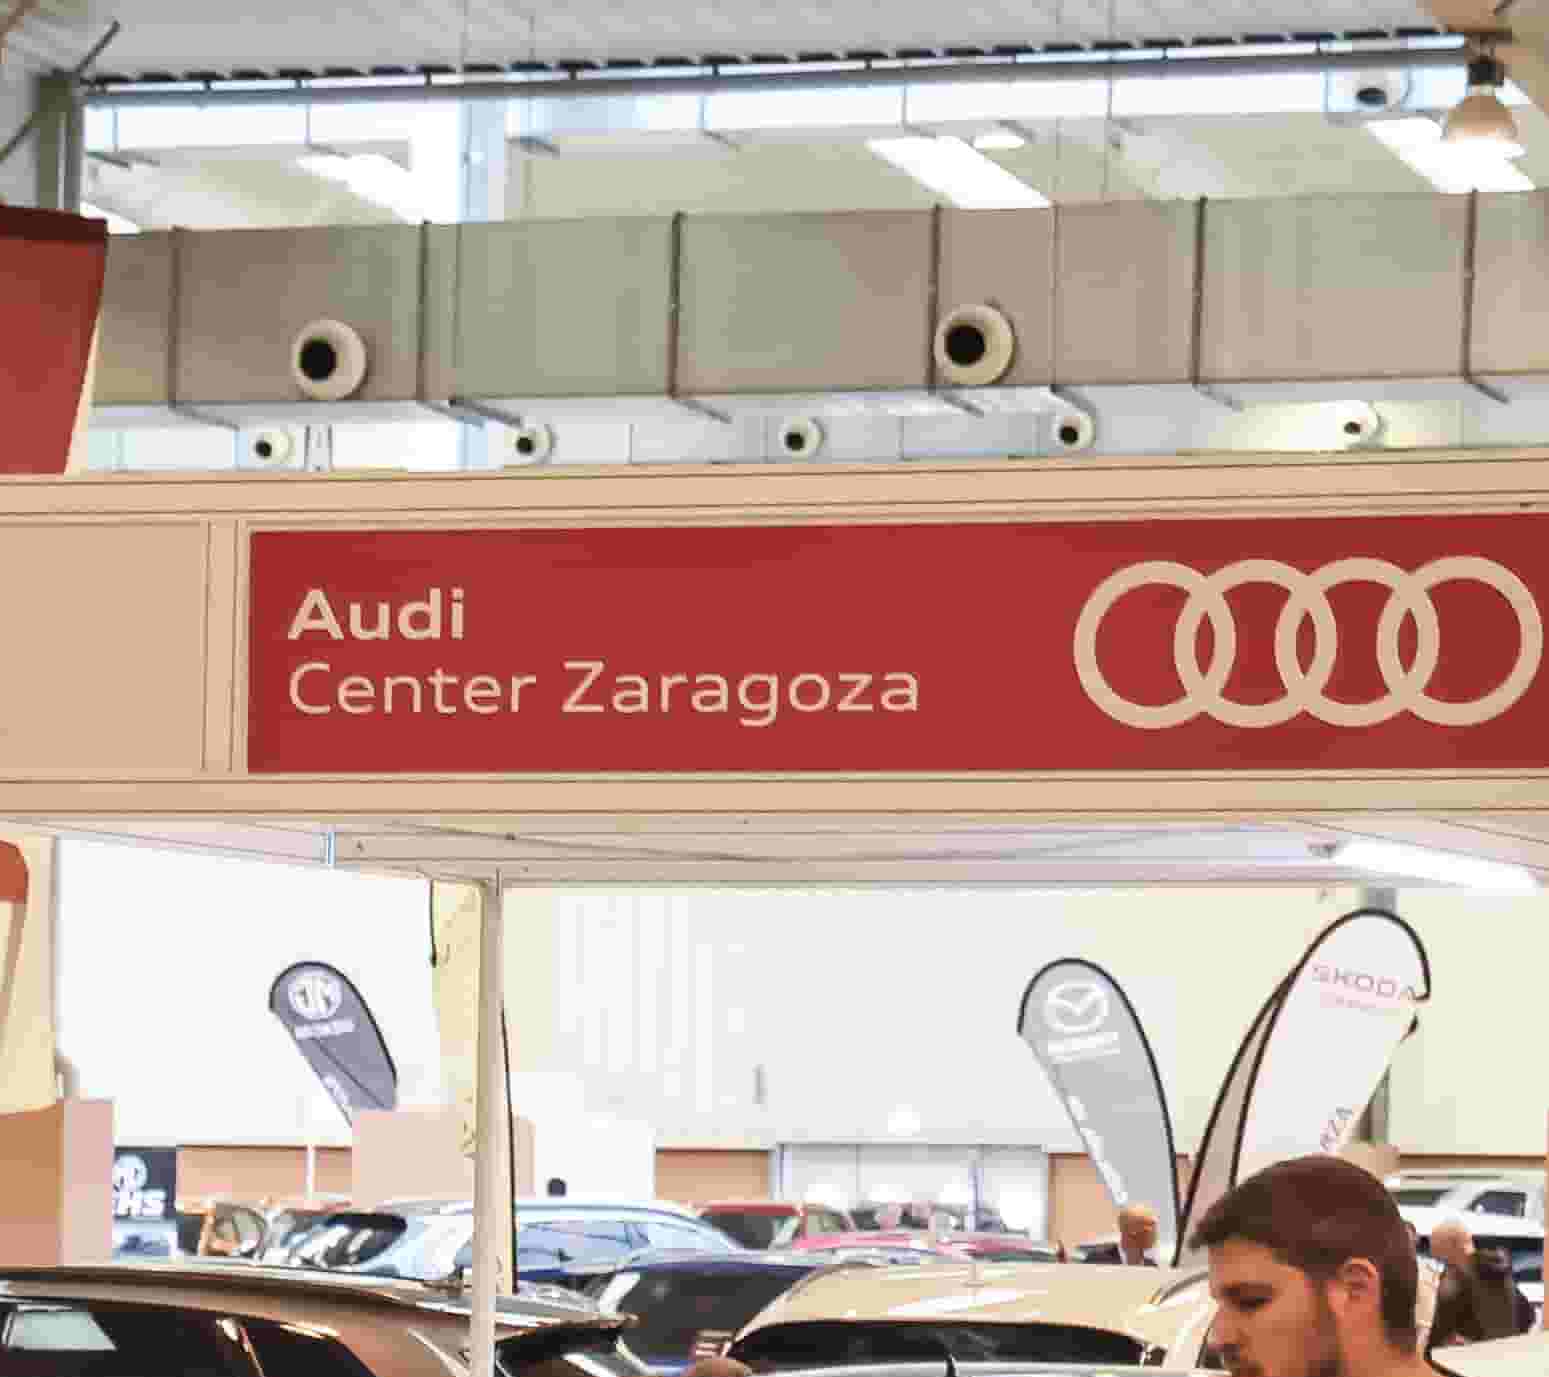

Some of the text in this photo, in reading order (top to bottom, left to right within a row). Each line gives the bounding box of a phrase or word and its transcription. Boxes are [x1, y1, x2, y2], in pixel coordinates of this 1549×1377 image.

[288, 586, 465, 640] Audi
[288, 660, 921, 727] Center Zaragoza
